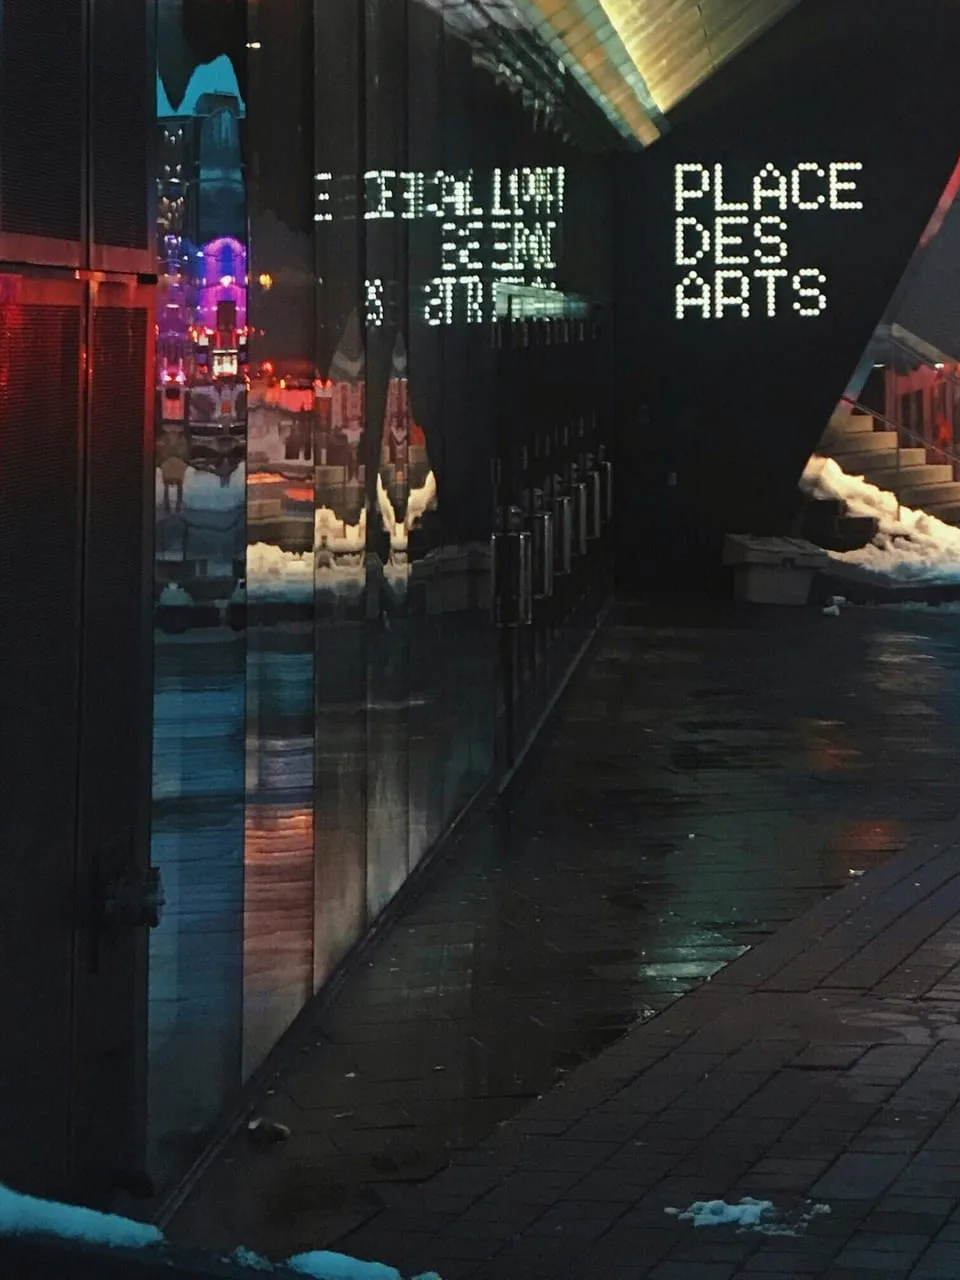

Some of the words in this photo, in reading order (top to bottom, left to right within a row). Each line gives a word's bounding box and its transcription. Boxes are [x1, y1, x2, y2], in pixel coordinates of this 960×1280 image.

[675, 162, 863, 211] PLACE
[675, 216, 788, 265] DES
[675, 269, 827, 319] ARTS
